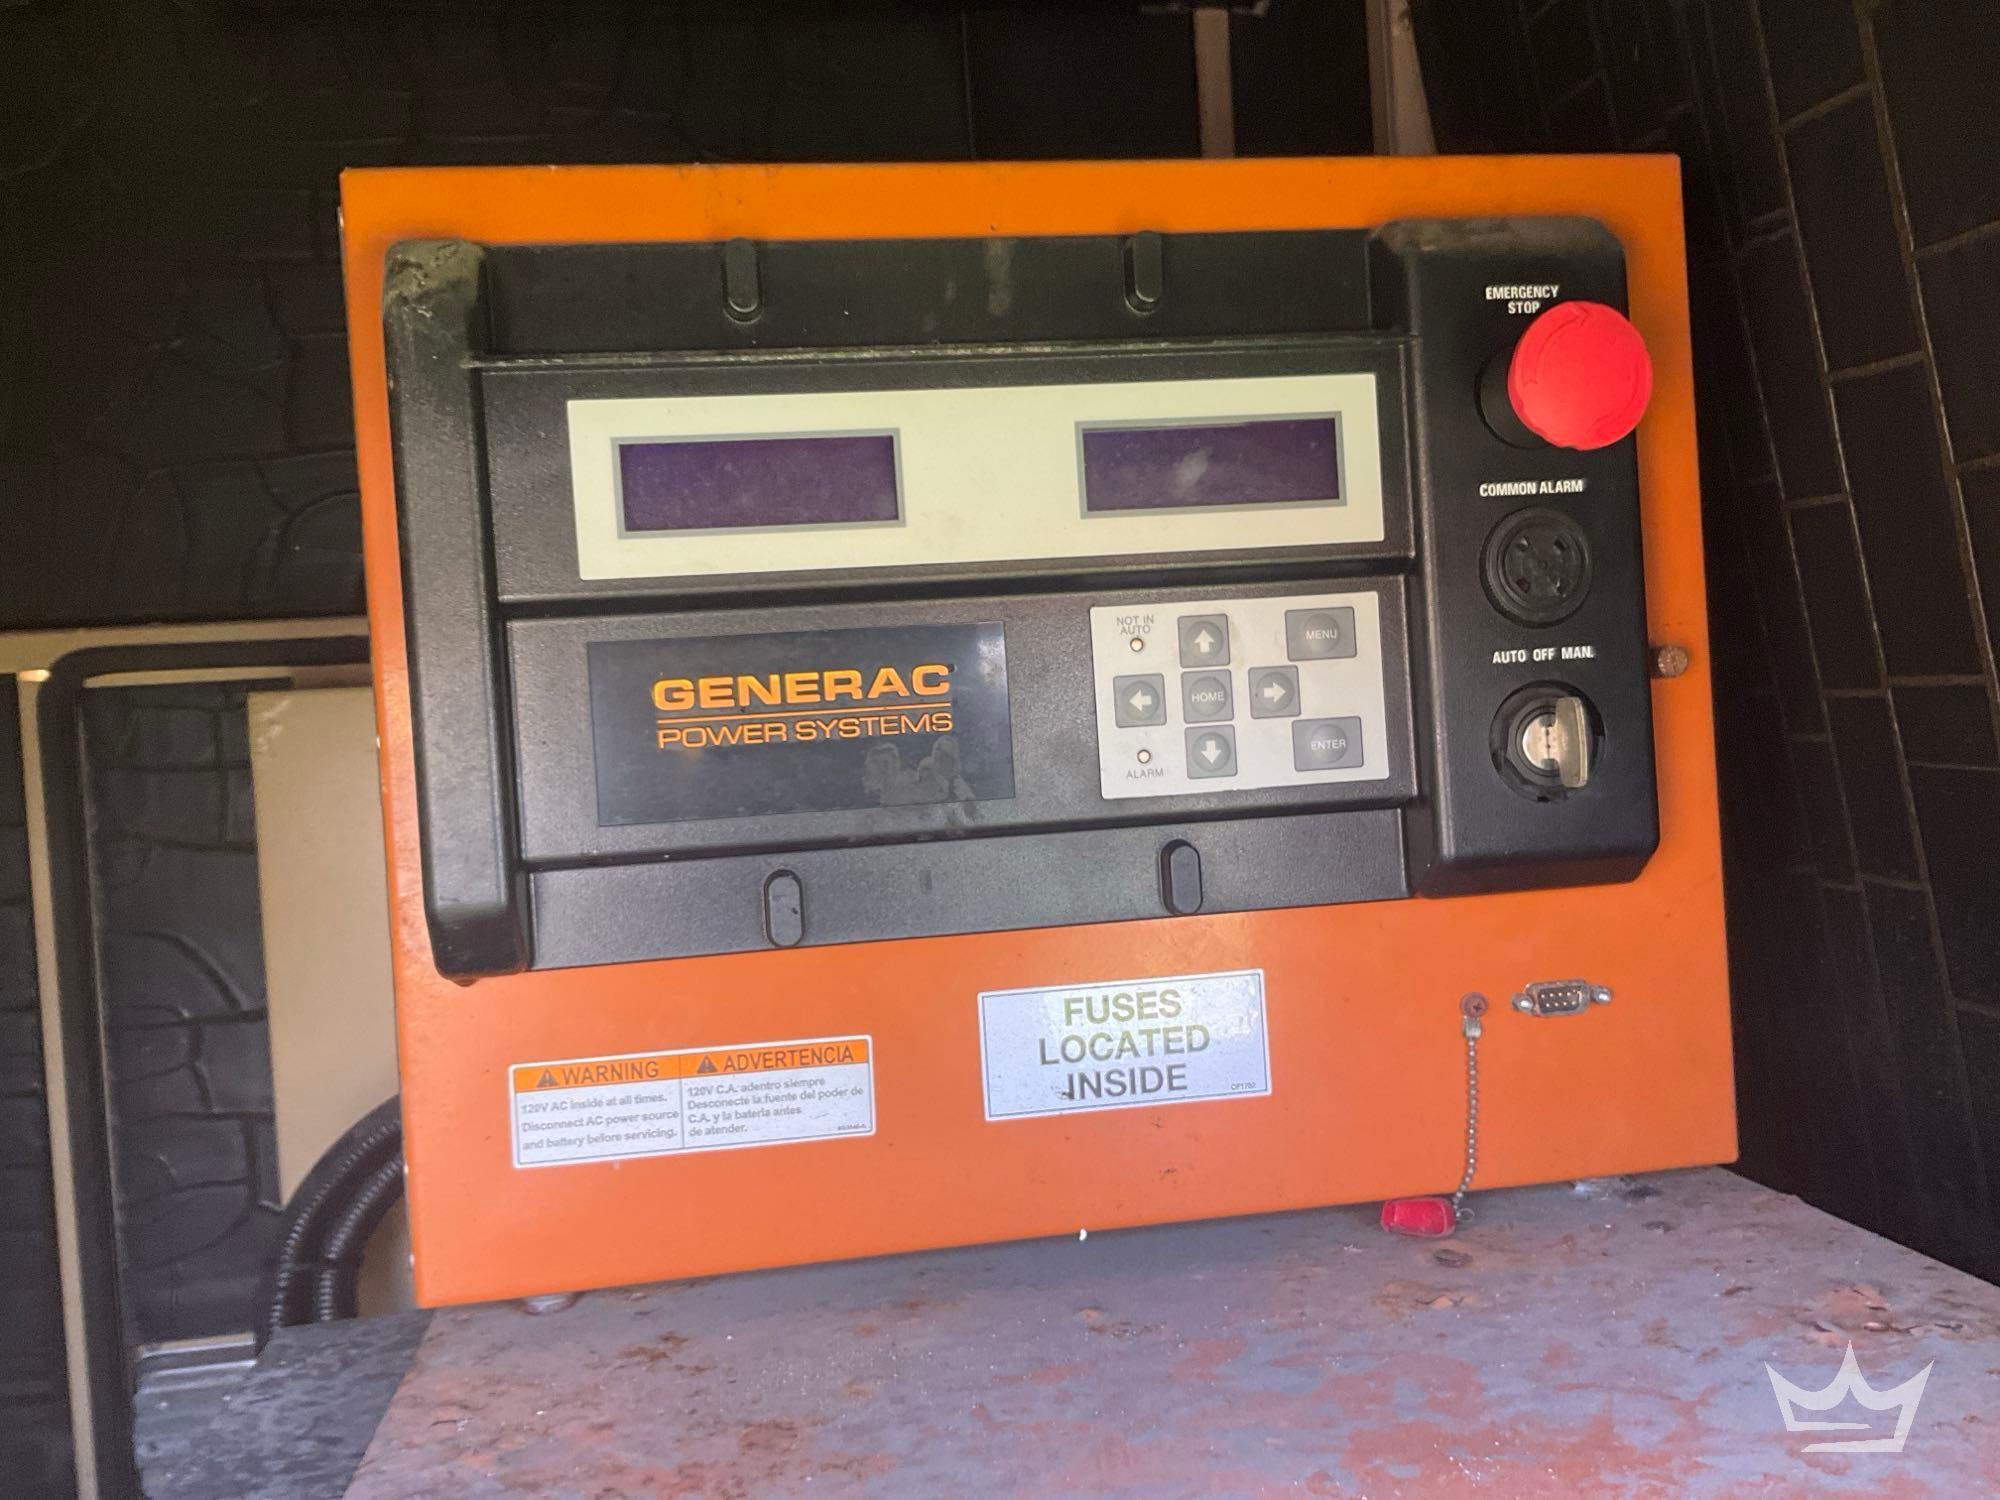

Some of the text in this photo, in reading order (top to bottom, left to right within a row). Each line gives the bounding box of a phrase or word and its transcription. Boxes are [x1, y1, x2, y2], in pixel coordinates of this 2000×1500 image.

[1486, 285, 1559, 300] EMERGENCY
[1508, 301, 1540, 315] STOP
[1479, 479, 1584, 497] COMMON ALARM
[1116, 614, 1155, 627] NOT IN
[1120, 624, 1151, 636] AUTO
[1305, 629, 1338, 640] MENU
[1492, 645, 1595, 664] AUTO OFF MAN.
[653, 664, 952, 711] GENERAC
[1191, 690, 1225, 703] HOME
[657, 712, 954, 750] POWER SYSTEMS
[1310, 738, 1347, 751] ENTER
[1126, 768, 1165, 780] ALARM
[1063, 988, 1183, 1027] FUSES
[1038, 1024, 1211, 1066] LOCATED
[723, 1045, 855, 1072] ADVERTENCIA
[562, 1061, 660, 1086] WARNING
[1066, 1063, 1188, 1101] INSIDE
[687, 1085, 714, 1097] 120V
[740, 1081, 781, 1093] adentro
[783, 1078, 826, 1089] siempre
[520, 1102, 548, 1114] 120V
[550, 1101, 568, 1112] AC
[570, 1097, 603, 1110] inside
[606, 1096, 617, 1107] at
[619, 1094, 632, 1106] all
[687, 1085, 864, 1110] Desconecte la fuente del poder de
[521, 1110, 680, 1132] Disconnect AC power source
[687, 1112, 711, 1124] C.A.
[712, 1113, 721, 1125] y
[721, 1110, 733, 1121] la
[773, 1106, 802, 1117] antes
[522, 1128, 678, 1150] and battery before servicing.
[687, 1123, 748, 1137] de atender.
